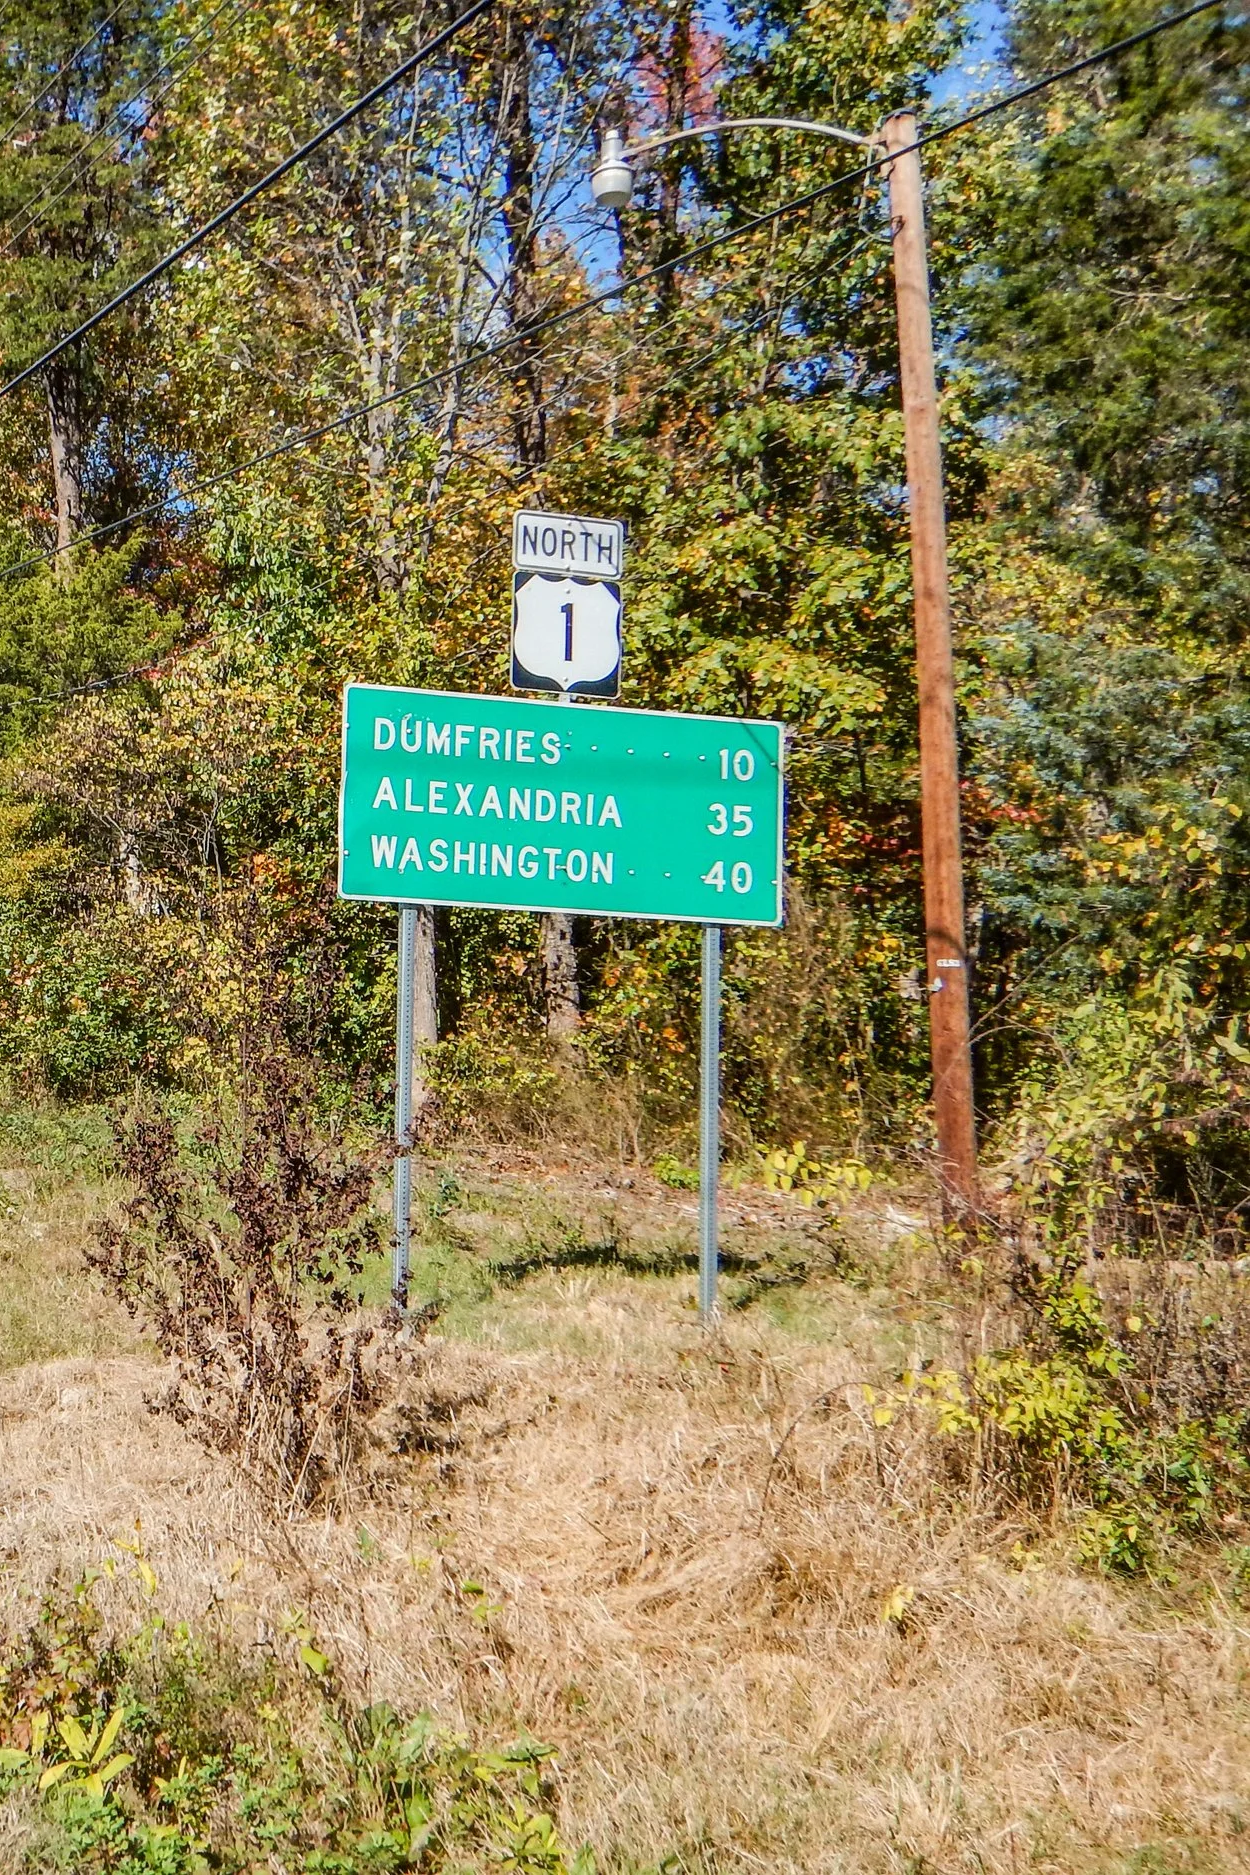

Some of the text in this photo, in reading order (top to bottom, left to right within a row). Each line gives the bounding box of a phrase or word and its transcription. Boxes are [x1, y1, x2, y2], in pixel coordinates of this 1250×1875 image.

[521, 525, 613, 565] NORTH
[561, 602, 573, 662] 1
[373, 717, 755, 782] DUMFRIES 10
[372, 777, 754, 838] ALEXANDRIA 35
[371, 835, 753, 894] WASHINGTON 40
